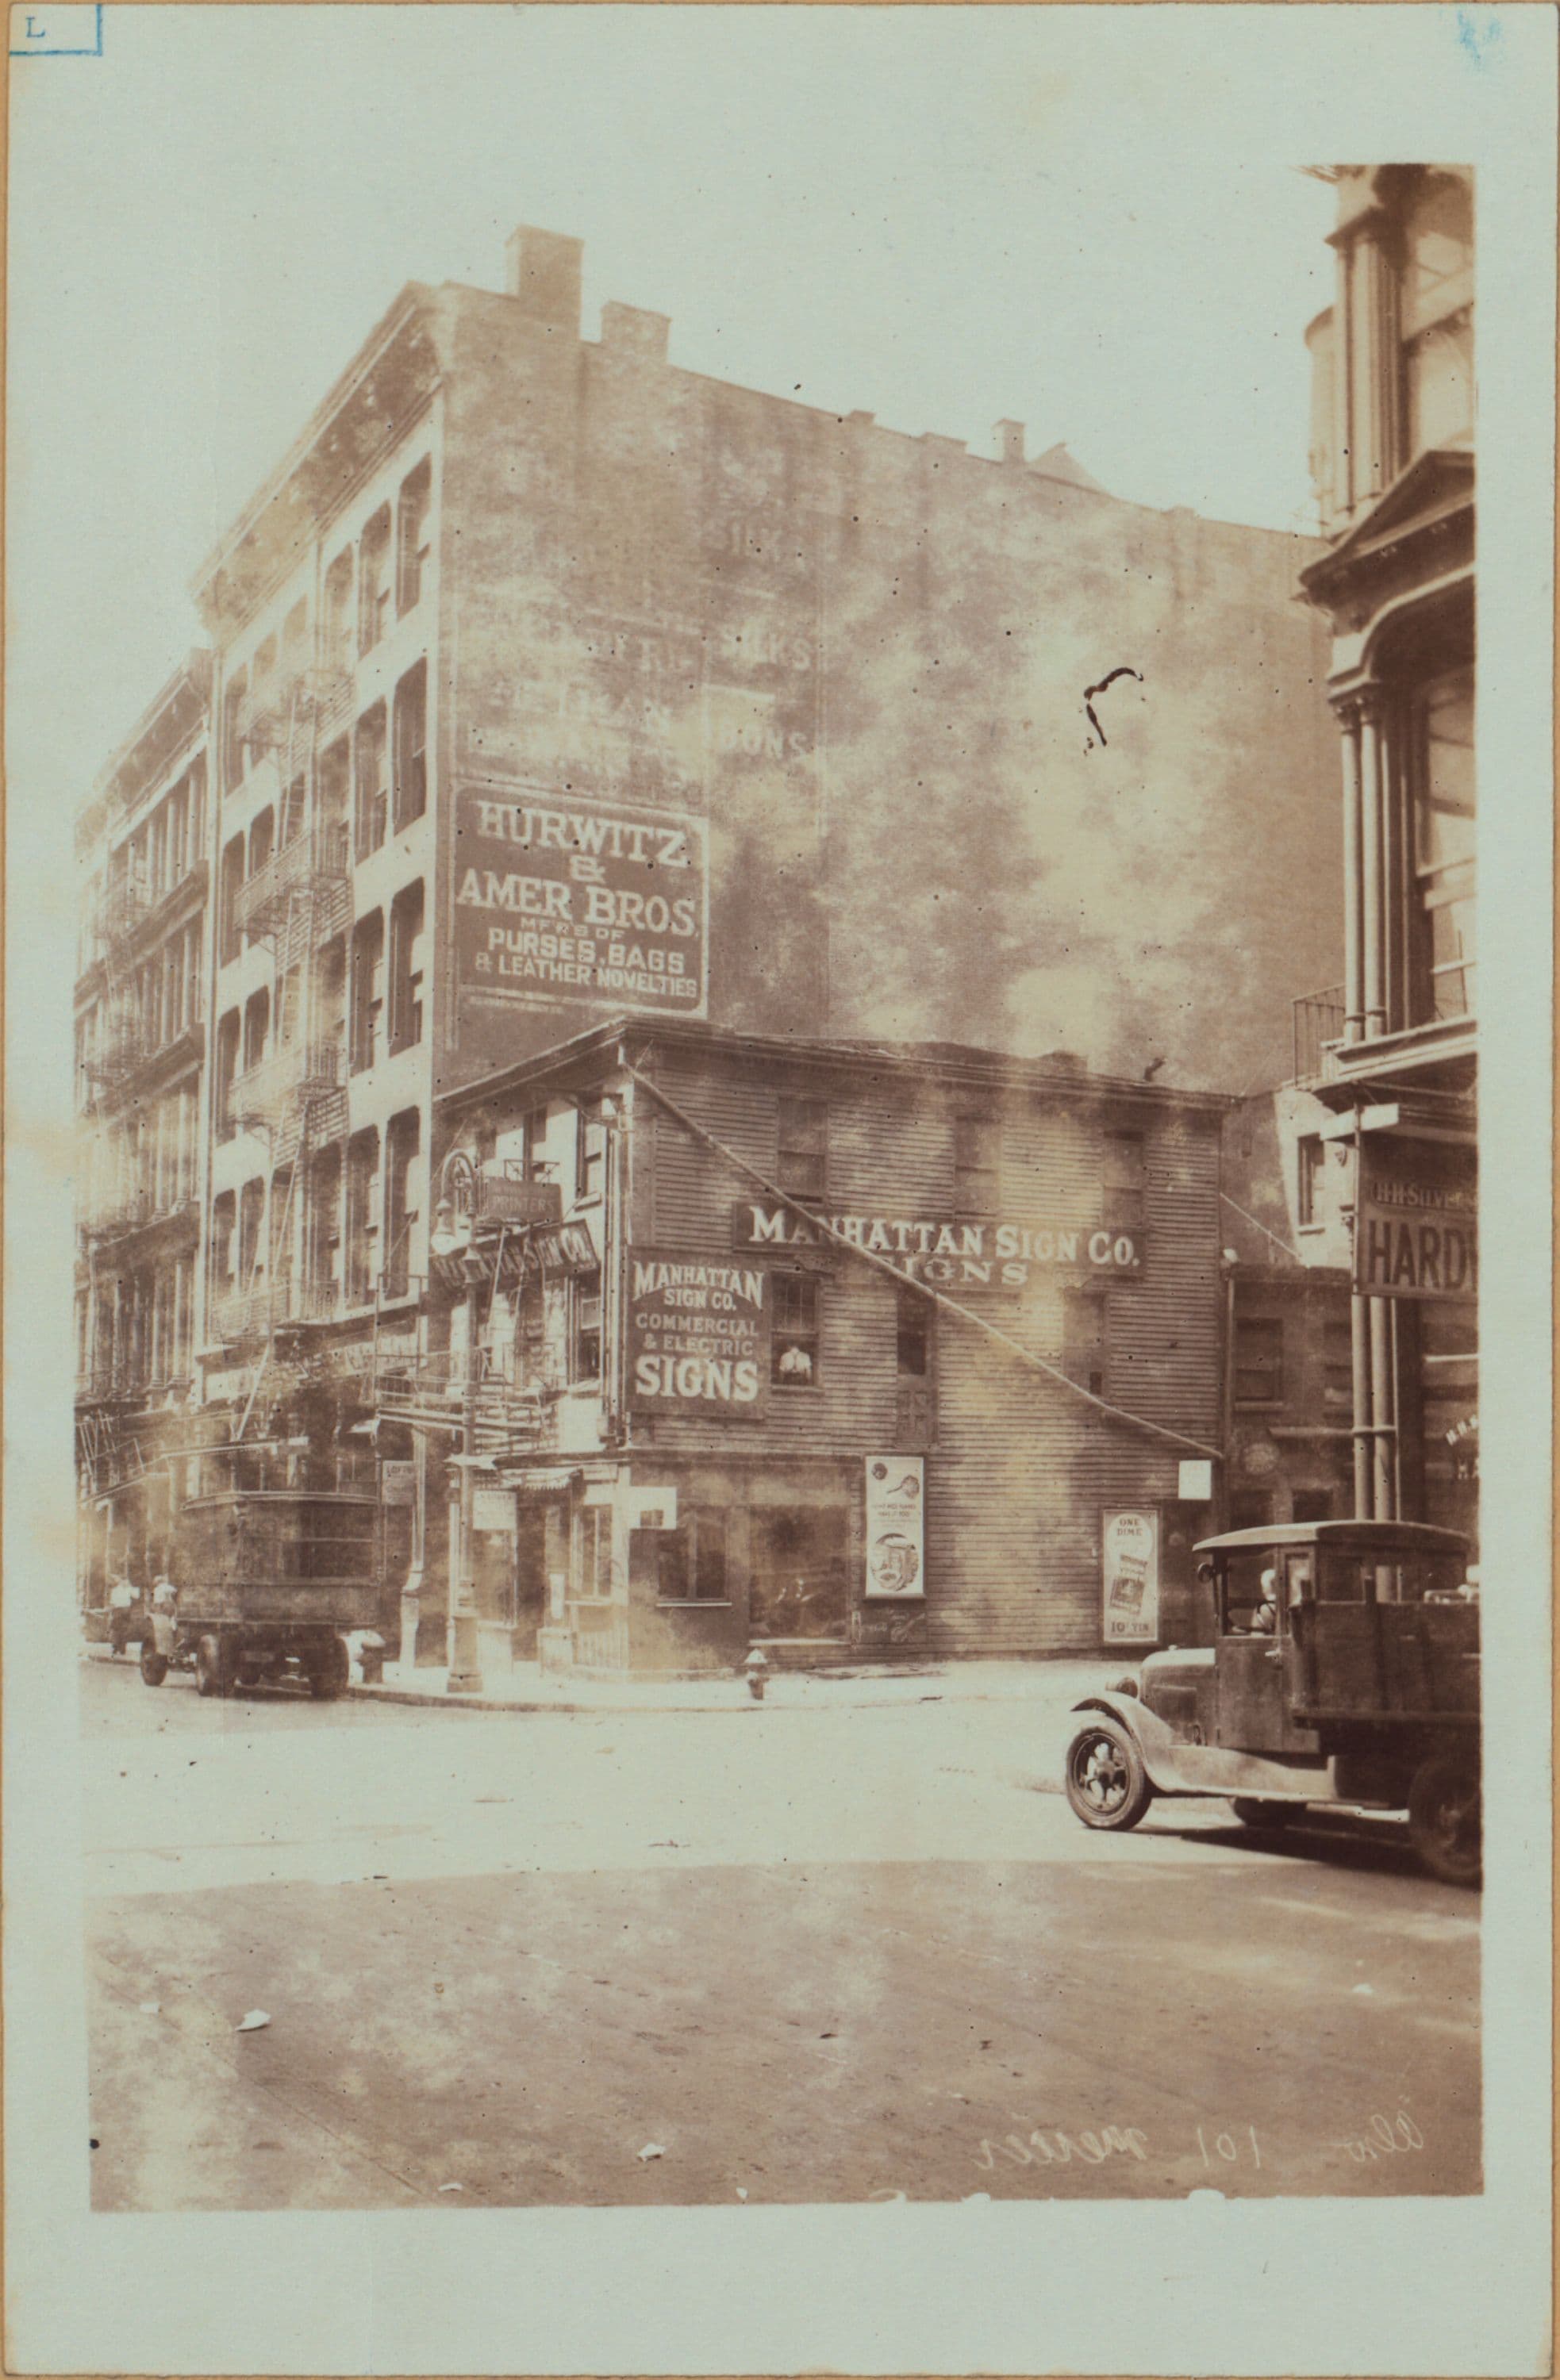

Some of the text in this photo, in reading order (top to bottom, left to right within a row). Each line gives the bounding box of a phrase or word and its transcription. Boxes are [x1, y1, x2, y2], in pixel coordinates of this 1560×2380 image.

[25, 17, 45, 38] L
[476, 799, 689, 869] HURWITZ
[569, 854, 606, 885] &
[456, 868, 574, 921] AMER
[596, 927, 626, 942] OF
[607, 942, 685, 975] BAGS
[476, 951, 698, 999] & LEATHER NOVELTIES
[492, 1195, 554, 1214] PRINTERS
[997, 1223, 1080, 1263] SIGN
[1368, 1219, 1477, 1291] HARD
[632, 1260, 766, 1310] MANHATTAN
[663, 1287, 737, 1311] SIGN CO.
[636, 1311, 759, 1338] COMMERCIAL
[643, 1333, 755, 1357] & ELECTRIC
[636, 1354, 759, 1403] SIGNS
[1116, 1526, 1143, 1537] DIME
[1119, 1517, 1139, 1527] ONE
